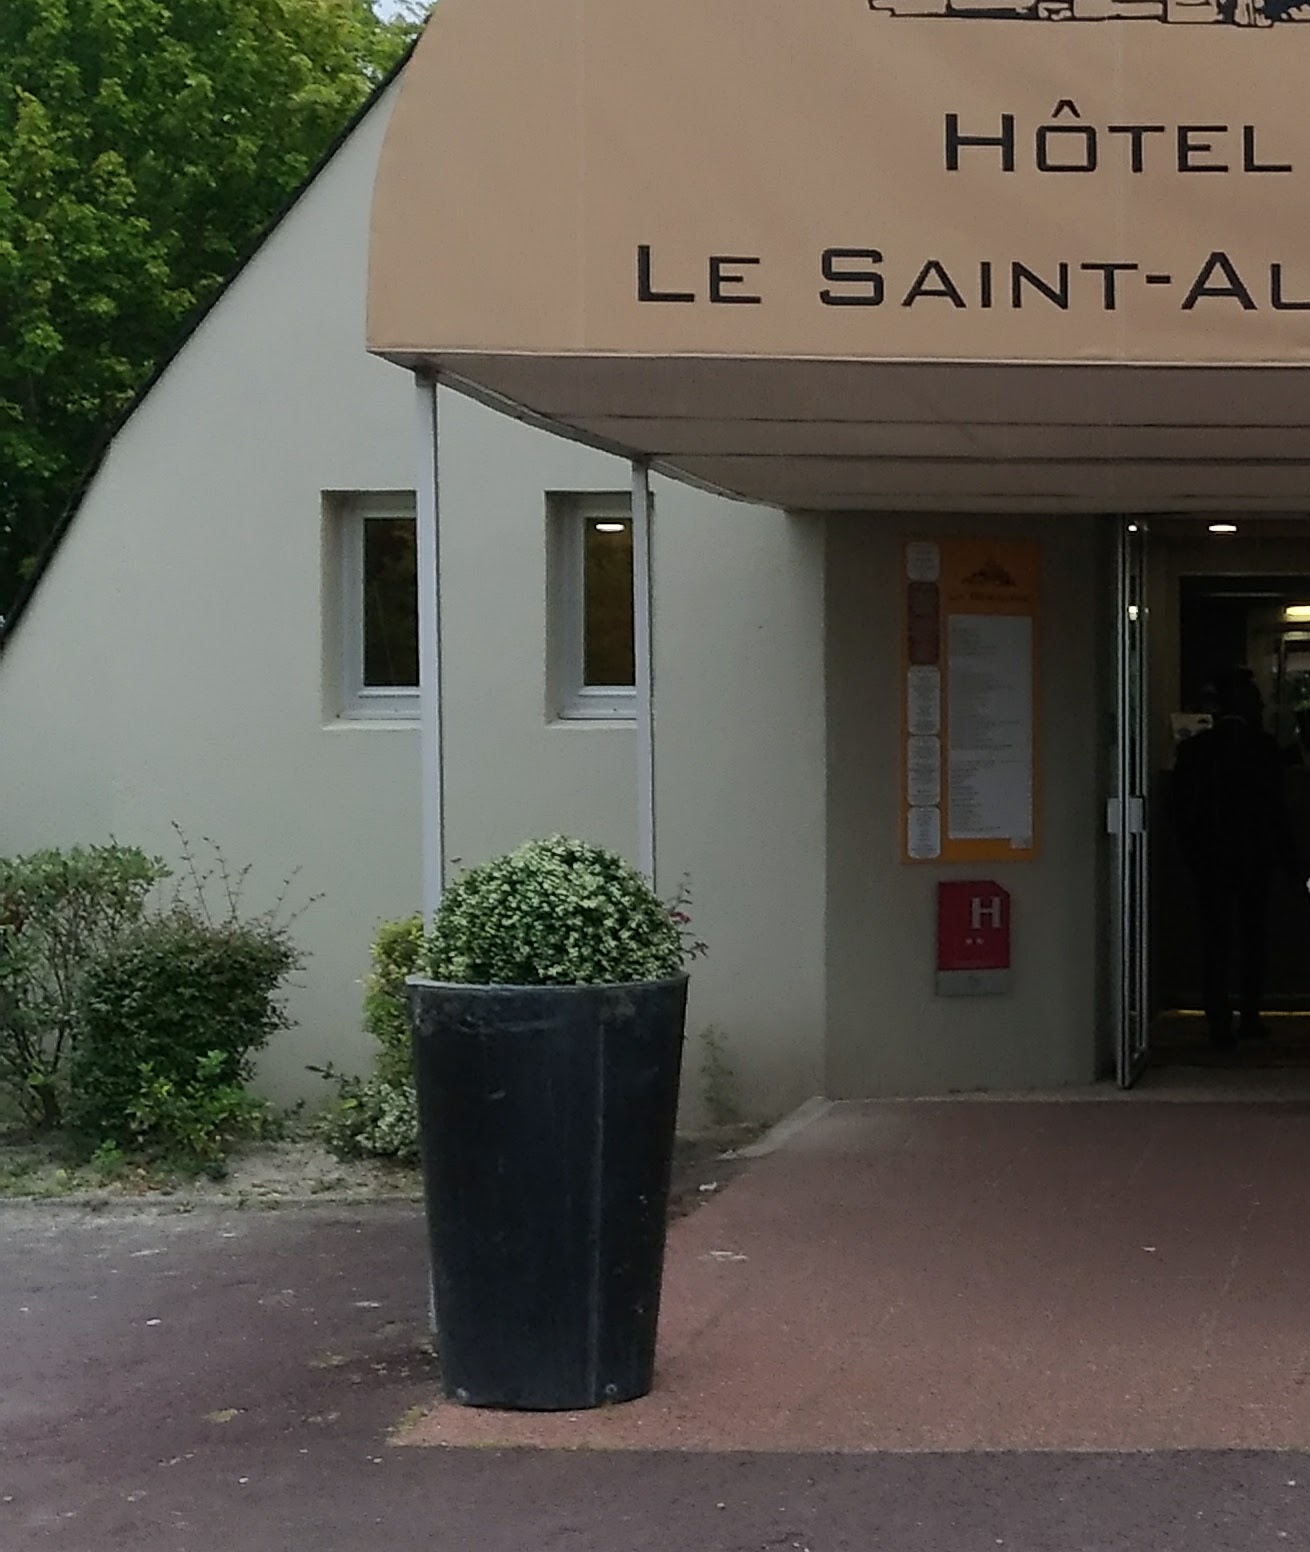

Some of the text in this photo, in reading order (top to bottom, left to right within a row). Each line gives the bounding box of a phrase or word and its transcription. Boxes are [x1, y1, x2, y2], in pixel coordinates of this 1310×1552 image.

[944, 99, 1294, 175] HÔTEL
[636, 244, 763, 306] LE
[971, 896, 1002, 929] H
